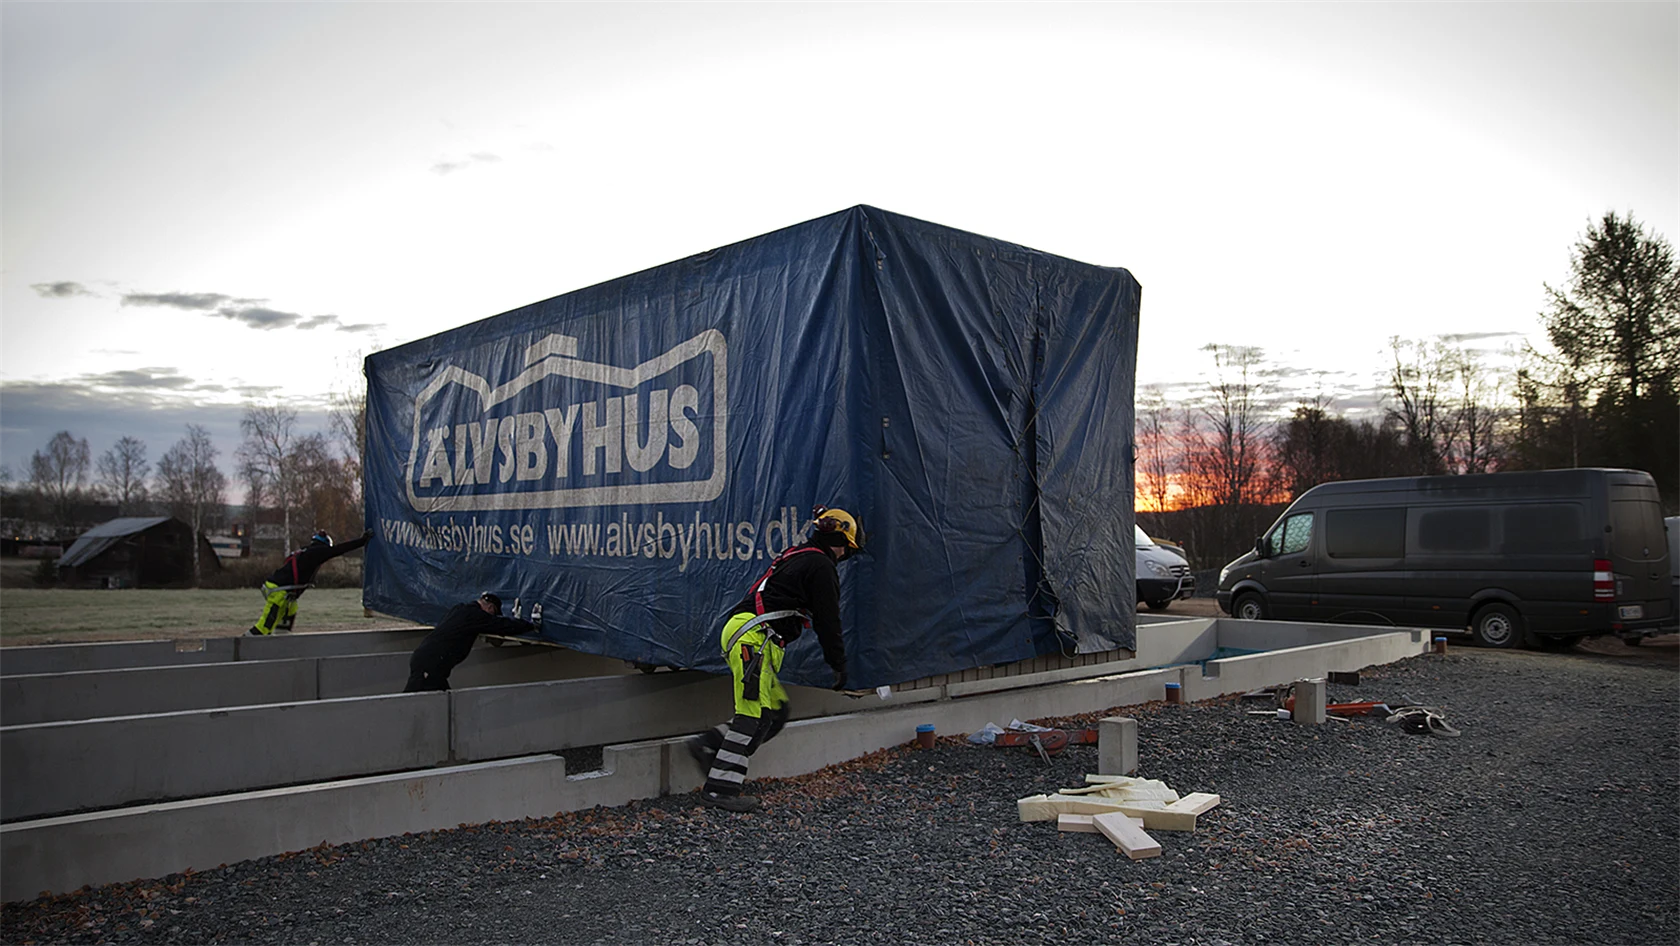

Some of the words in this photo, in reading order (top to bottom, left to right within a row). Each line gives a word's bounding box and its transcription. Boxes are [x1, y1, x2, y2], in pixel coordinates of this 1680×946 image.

[419, 384, 700, 488] ÄLVSBYHUS
[381, 516, 534, 562] www.alvsbyhus.se
[547, 506, 813, 573] www.alvsbyhus.dk
